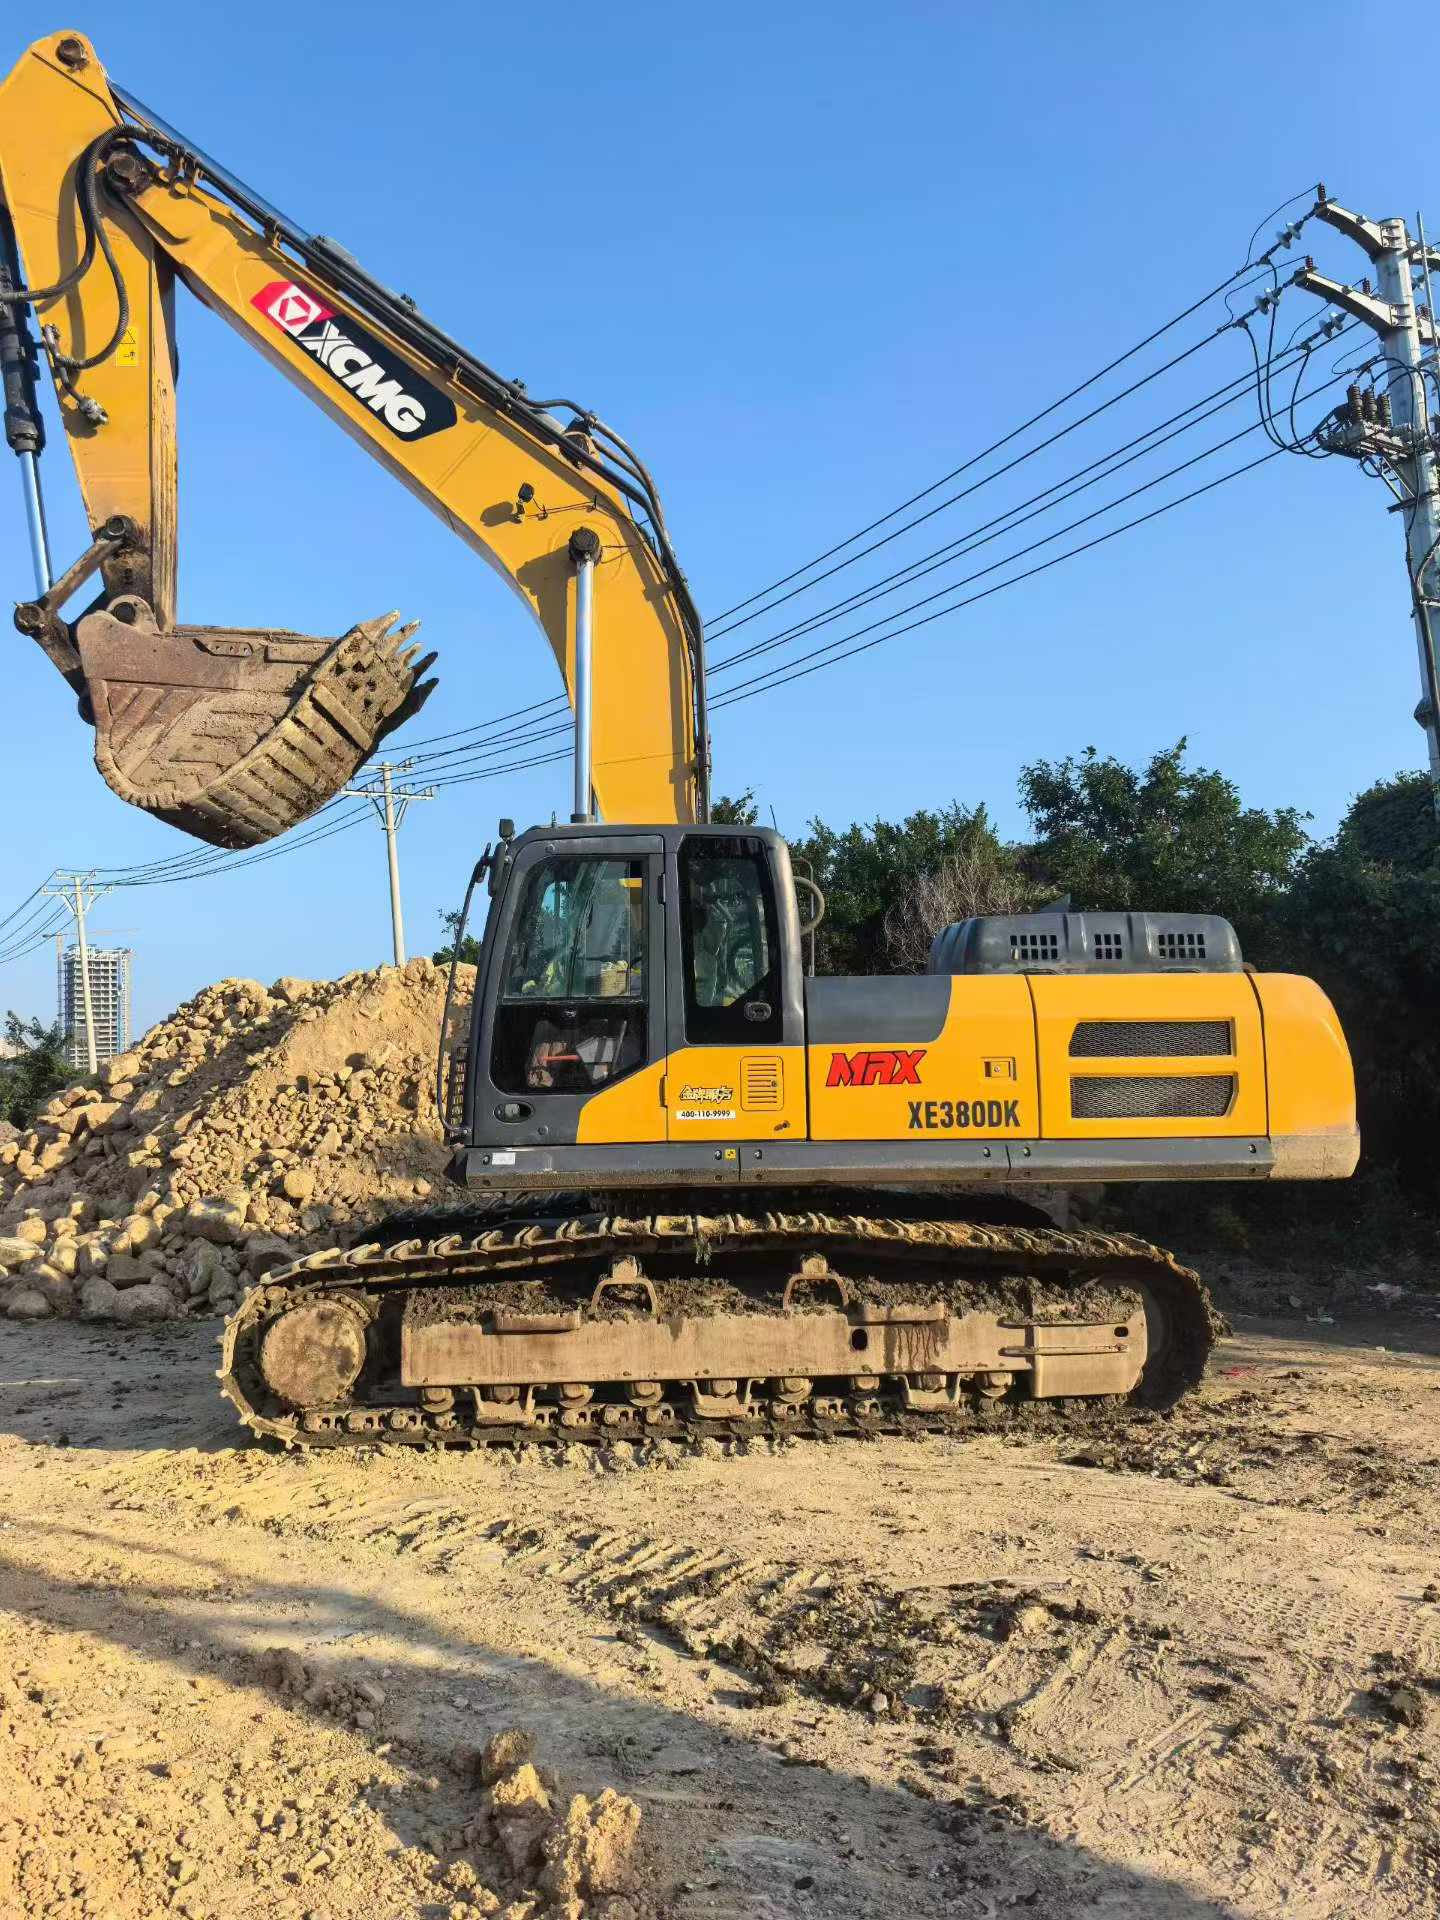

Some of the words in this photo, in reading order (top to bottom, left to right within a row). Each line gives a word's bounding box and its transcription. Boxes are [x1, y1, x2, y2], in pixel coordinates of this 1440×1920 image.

[298, 321, 426, 433] XCMG
[826, 1050, 926, 1087] MAX
[681, 1110, 731, 1118] 400-110-9999
[908, 1101, 1020, 1129] XE380DK
